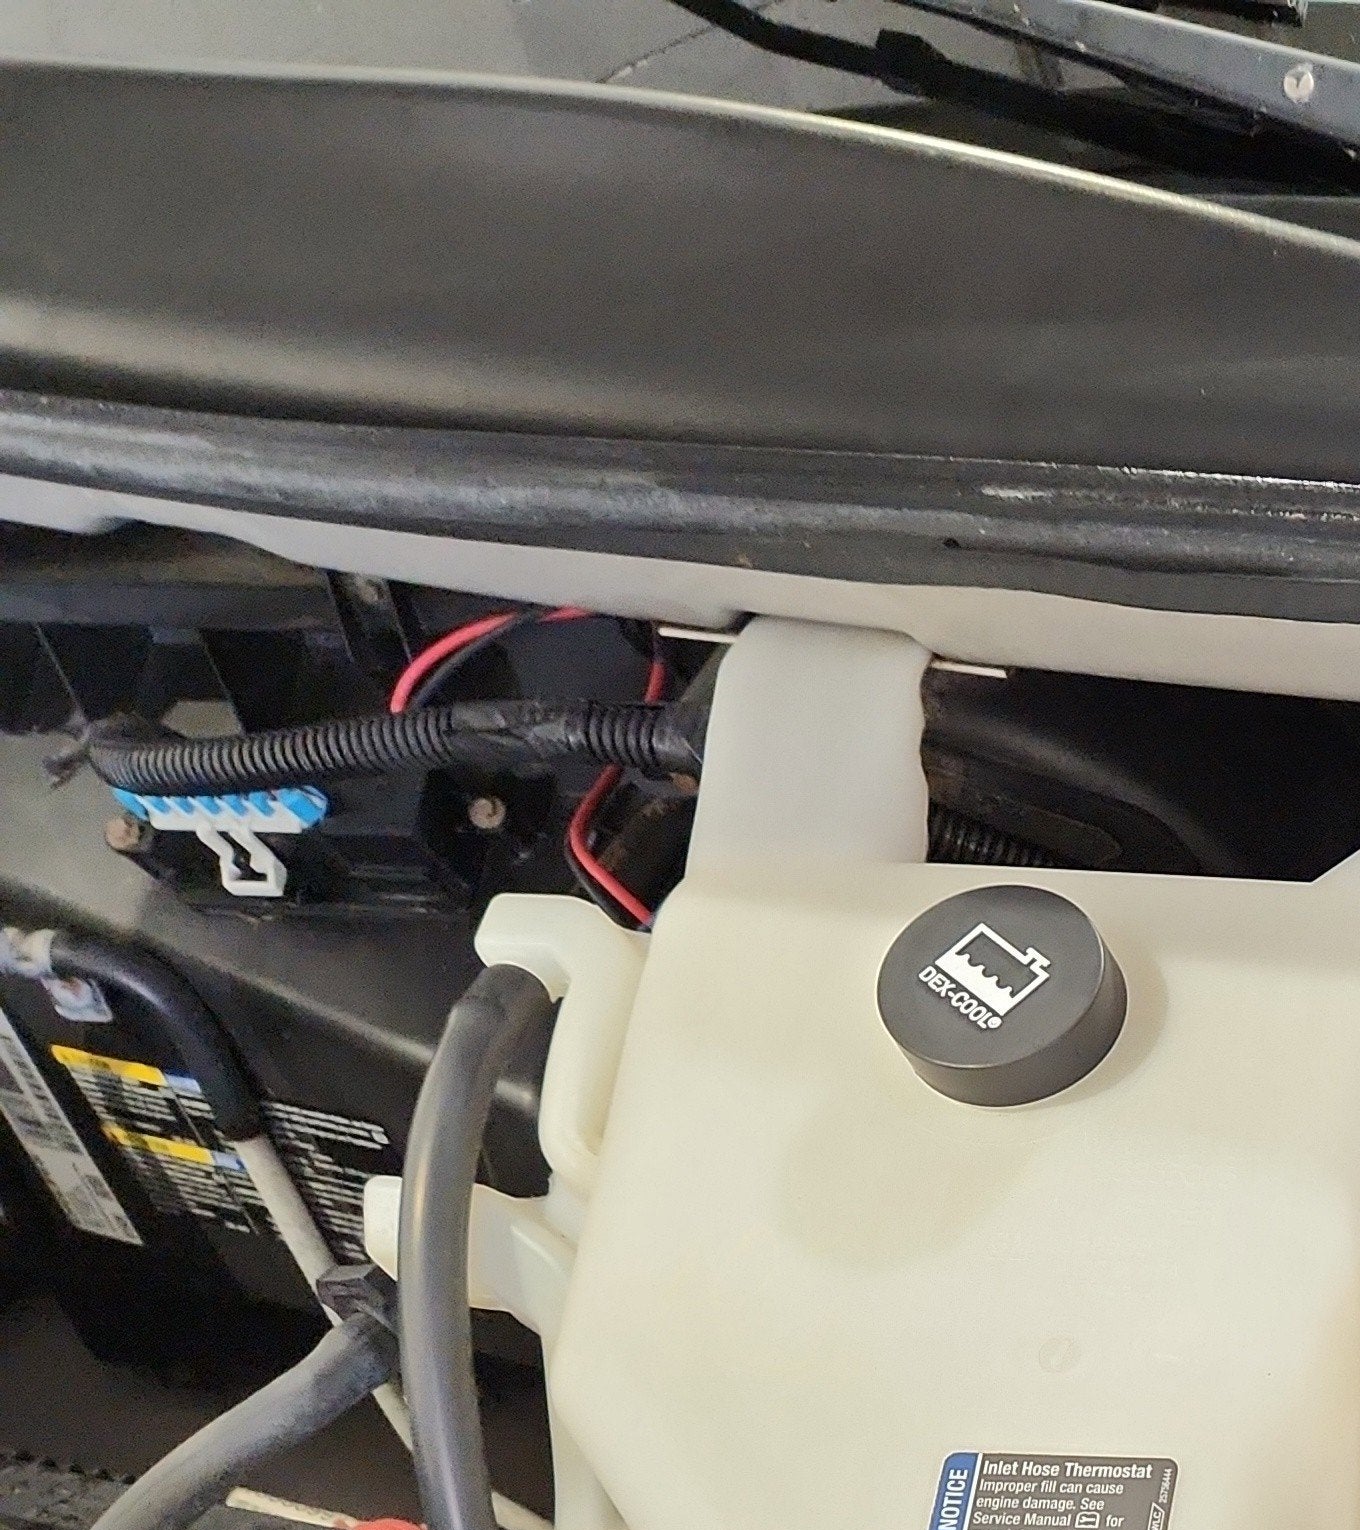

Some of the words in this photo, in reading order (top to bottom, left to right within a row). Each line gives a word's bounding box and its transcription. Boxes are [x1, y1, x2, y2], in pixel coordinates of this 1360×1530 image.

[983, 1460, 1017, 1476] Inlet
[1022, 1462, 1059, 1477] Hose
[1065, 1463, 1152, 1479] Thermostat
[980, 1479, 1038, 1494] Improper
[1040, 1480, 1056, 1492] fill
[1060, 1483, 1082, 1493] can
[1086, 1484, 1123, 1494] cause
[938, 1469, 968, 1530] NOTICE
[976, 1499, 1019, 1510] engine
[1023, 1499, 1076, 1511] damage.
[1080, 1499, 1104, 1510] See
[973, 1512, 1020, 1525] Service
[1024, 1514, 1071, 1526] Manual
[1106, 1515, 1124, 1527] for
